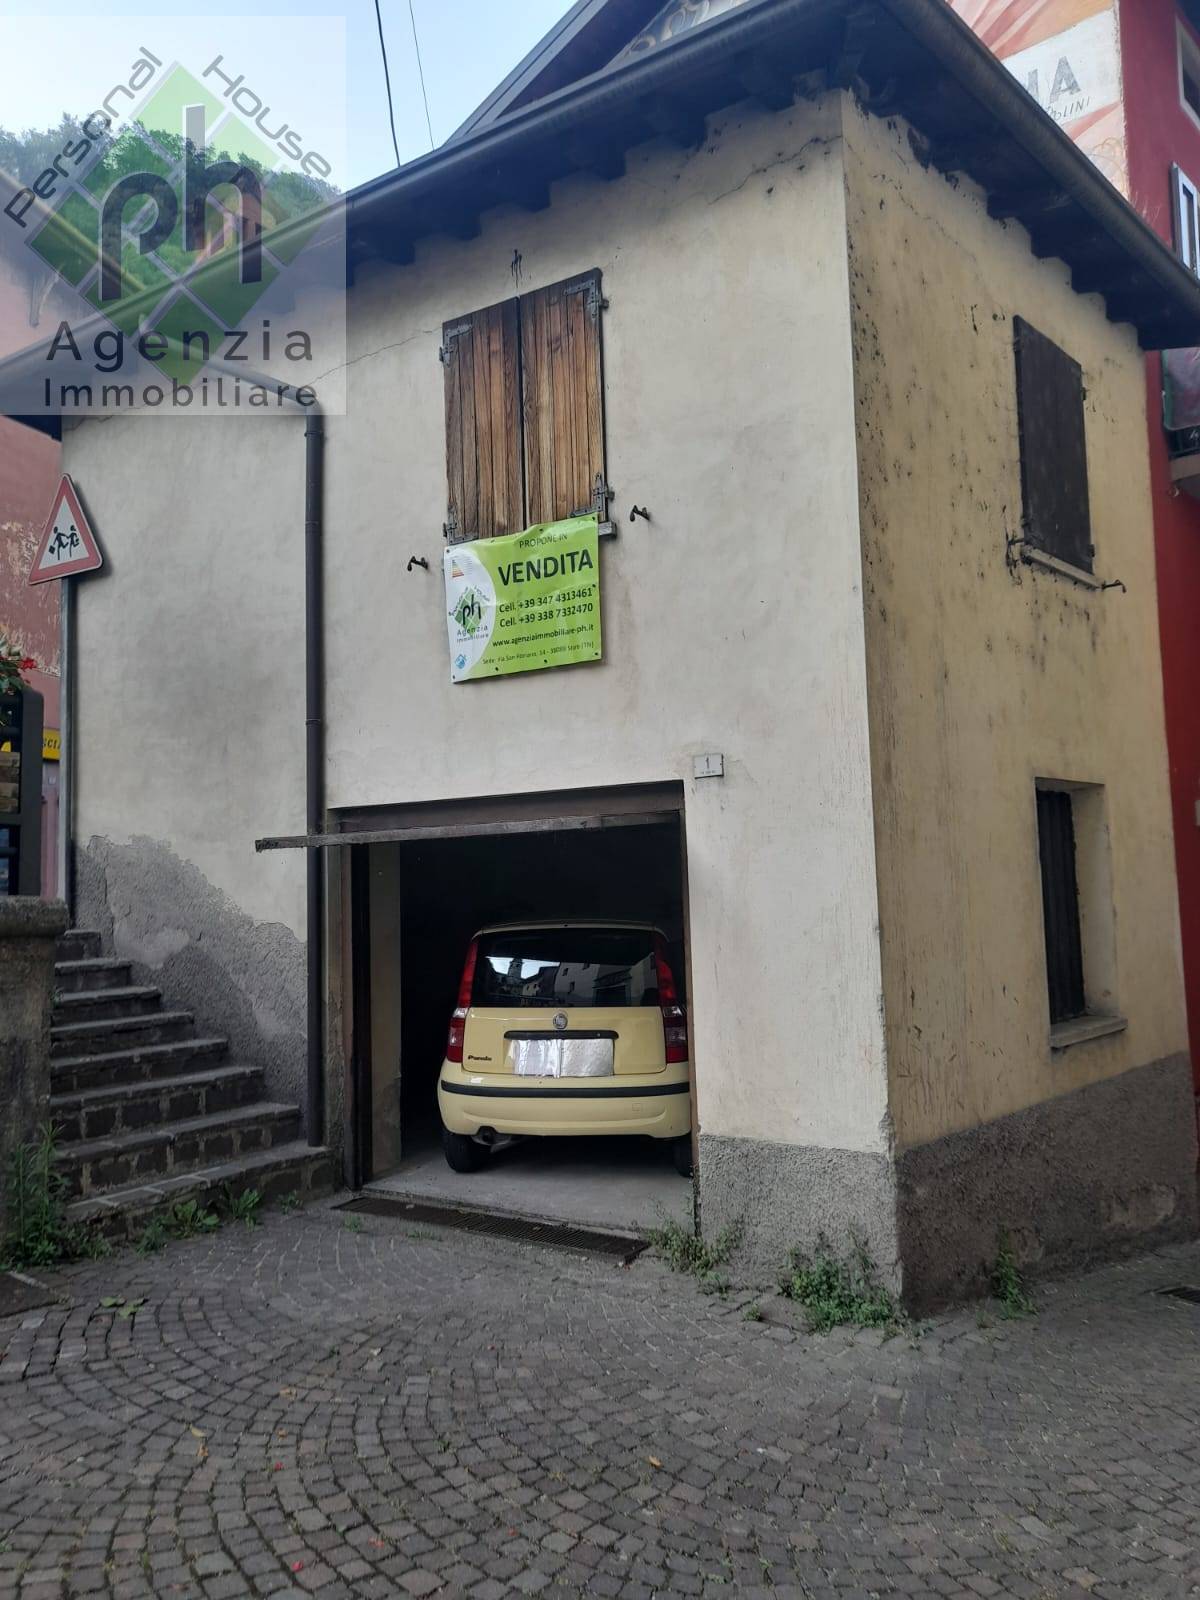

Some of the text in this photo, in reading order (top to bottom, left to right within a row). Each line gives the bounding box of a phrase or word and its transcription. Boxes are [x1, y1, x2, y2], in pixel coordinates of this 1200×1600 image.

[519, 533, 568, 549] PROPONE IN
[498, 549, 594, 586] VENDITA
[462, 593, 482, 626] ph
[499, 587, 593, 613] Cell. +39 347 4313461
[499, 603, 593, 628] Cell. +39 338 7332470
[457, 625, 488, 637] Agenzia
[705, 756, 710, 769] 1
